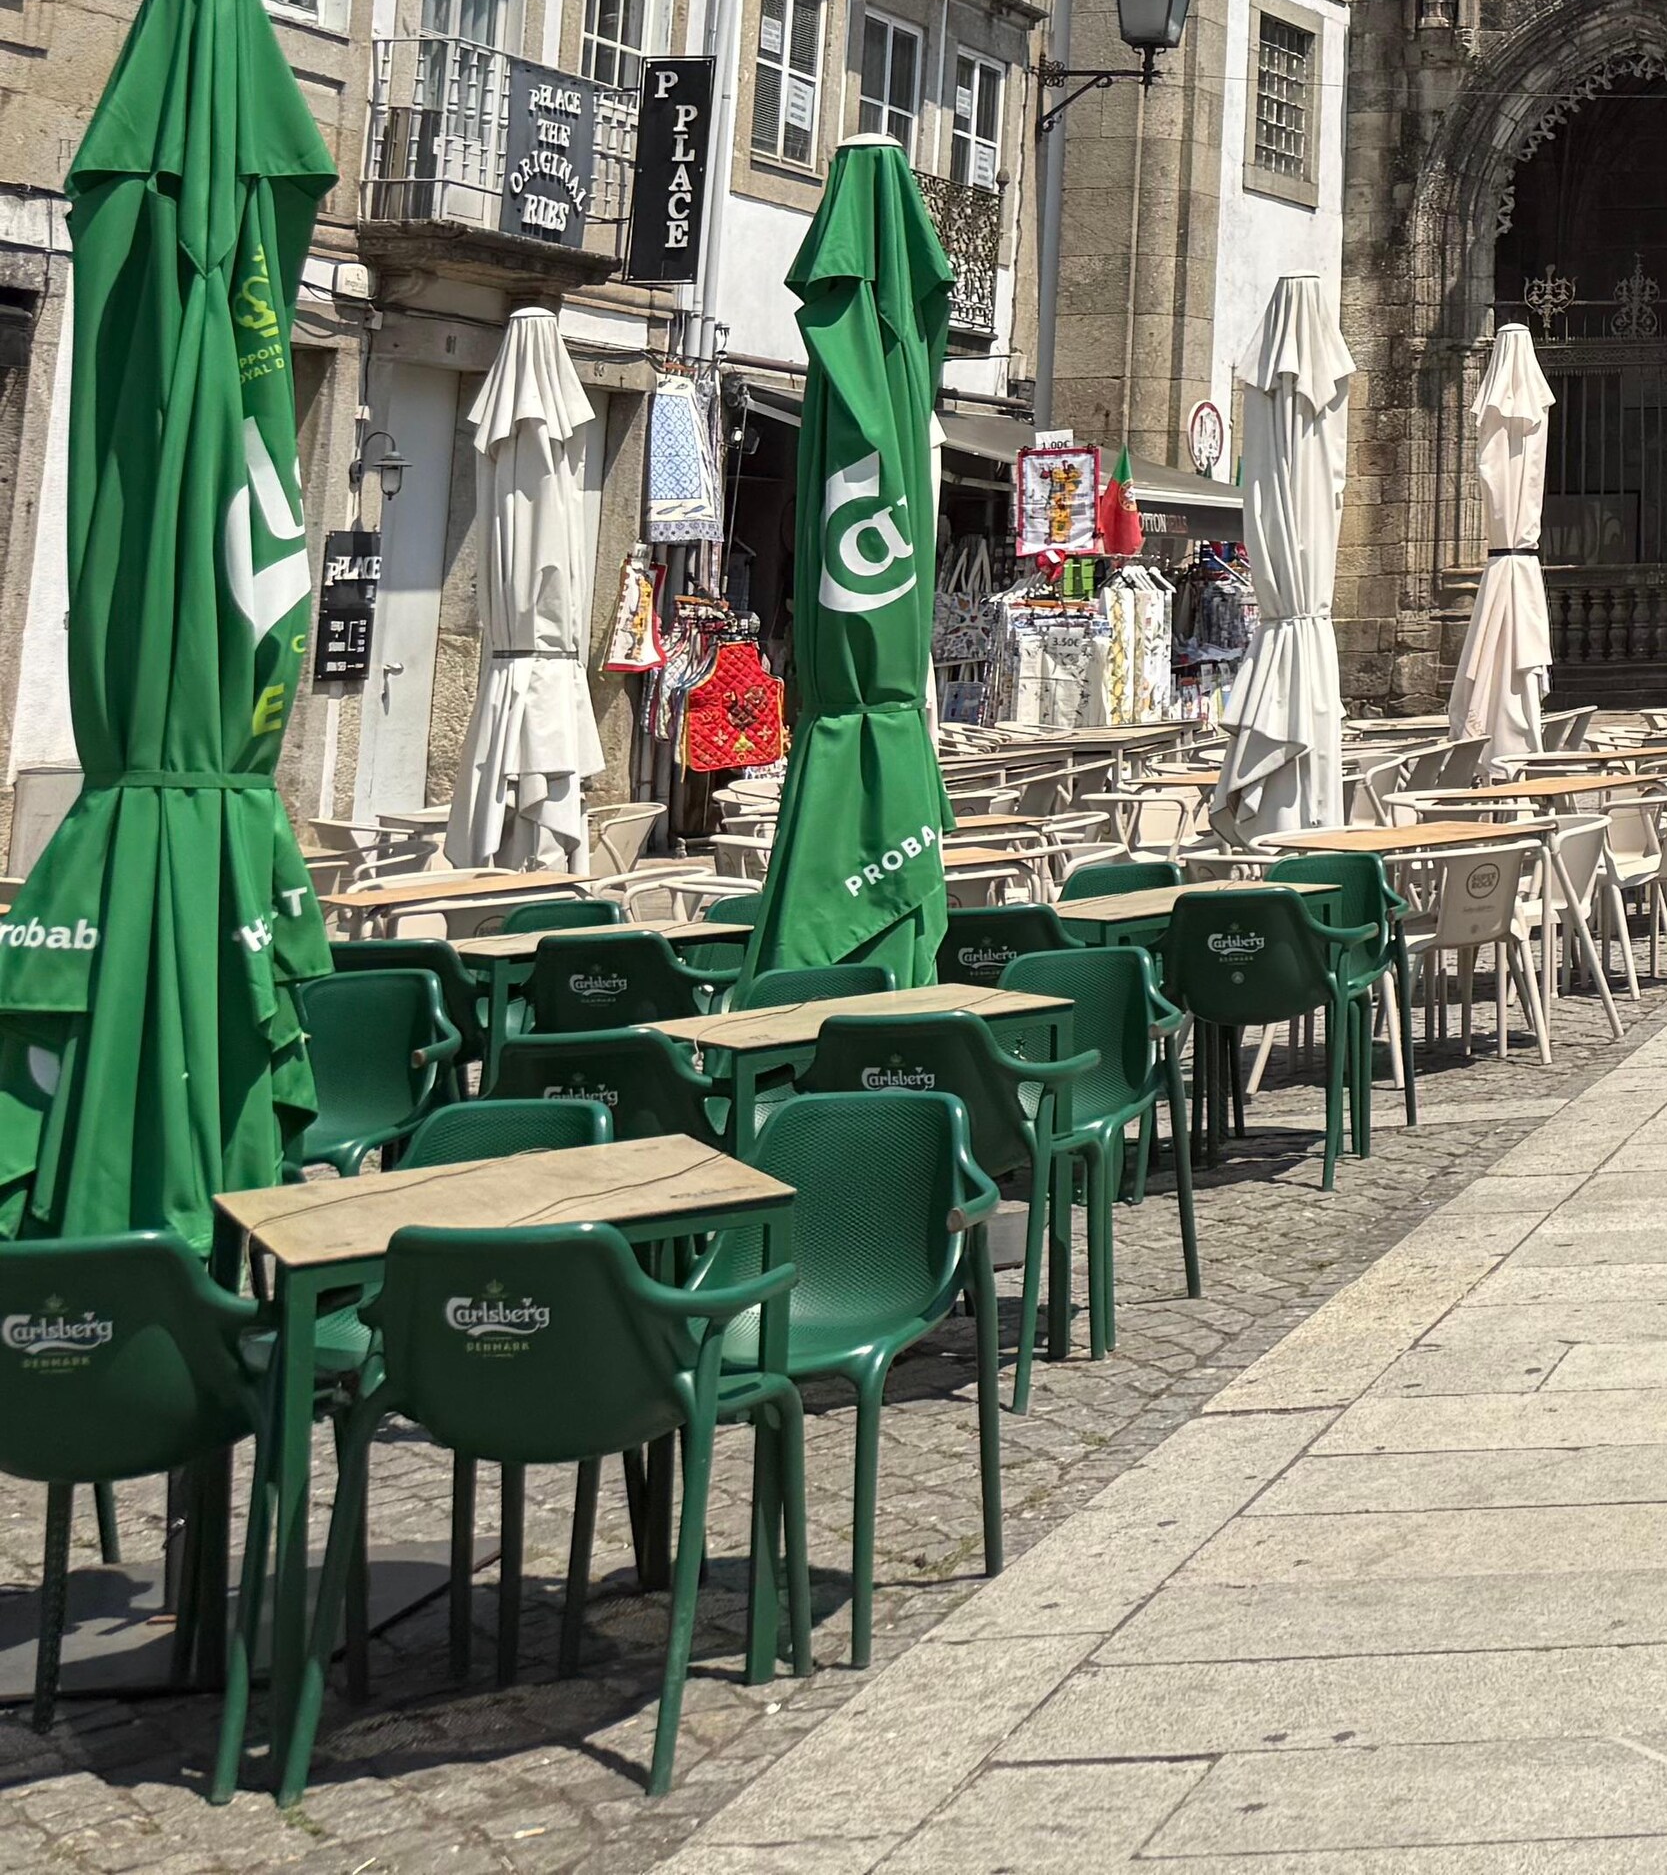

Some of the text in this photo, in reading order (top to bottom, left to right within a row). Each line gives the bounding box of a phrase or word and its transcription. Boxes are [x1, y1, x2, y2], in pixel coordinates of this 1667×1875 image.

[537, 119, 571, 148] THE
[510, 150, 588, 212] ORIGINAL
[521, 193, 570, 232] RIBS
[844, 824, 937, 898] PROBA
[1207, 932, 1265, 954] Carlsberg
[958, 946, 1018, 969] Carlsberg
[569, 973, 628, 996] Carlsberg
[861, 1067, 936, 1092] Carlsberg
[446, 1297, 551, 1334] Carlsberg
[2, 1311, 114, 1353] Carlsberg
[466, 1341, 530, 1353] DENMARK
[23, 1356, 91, 1369] DENMARK
